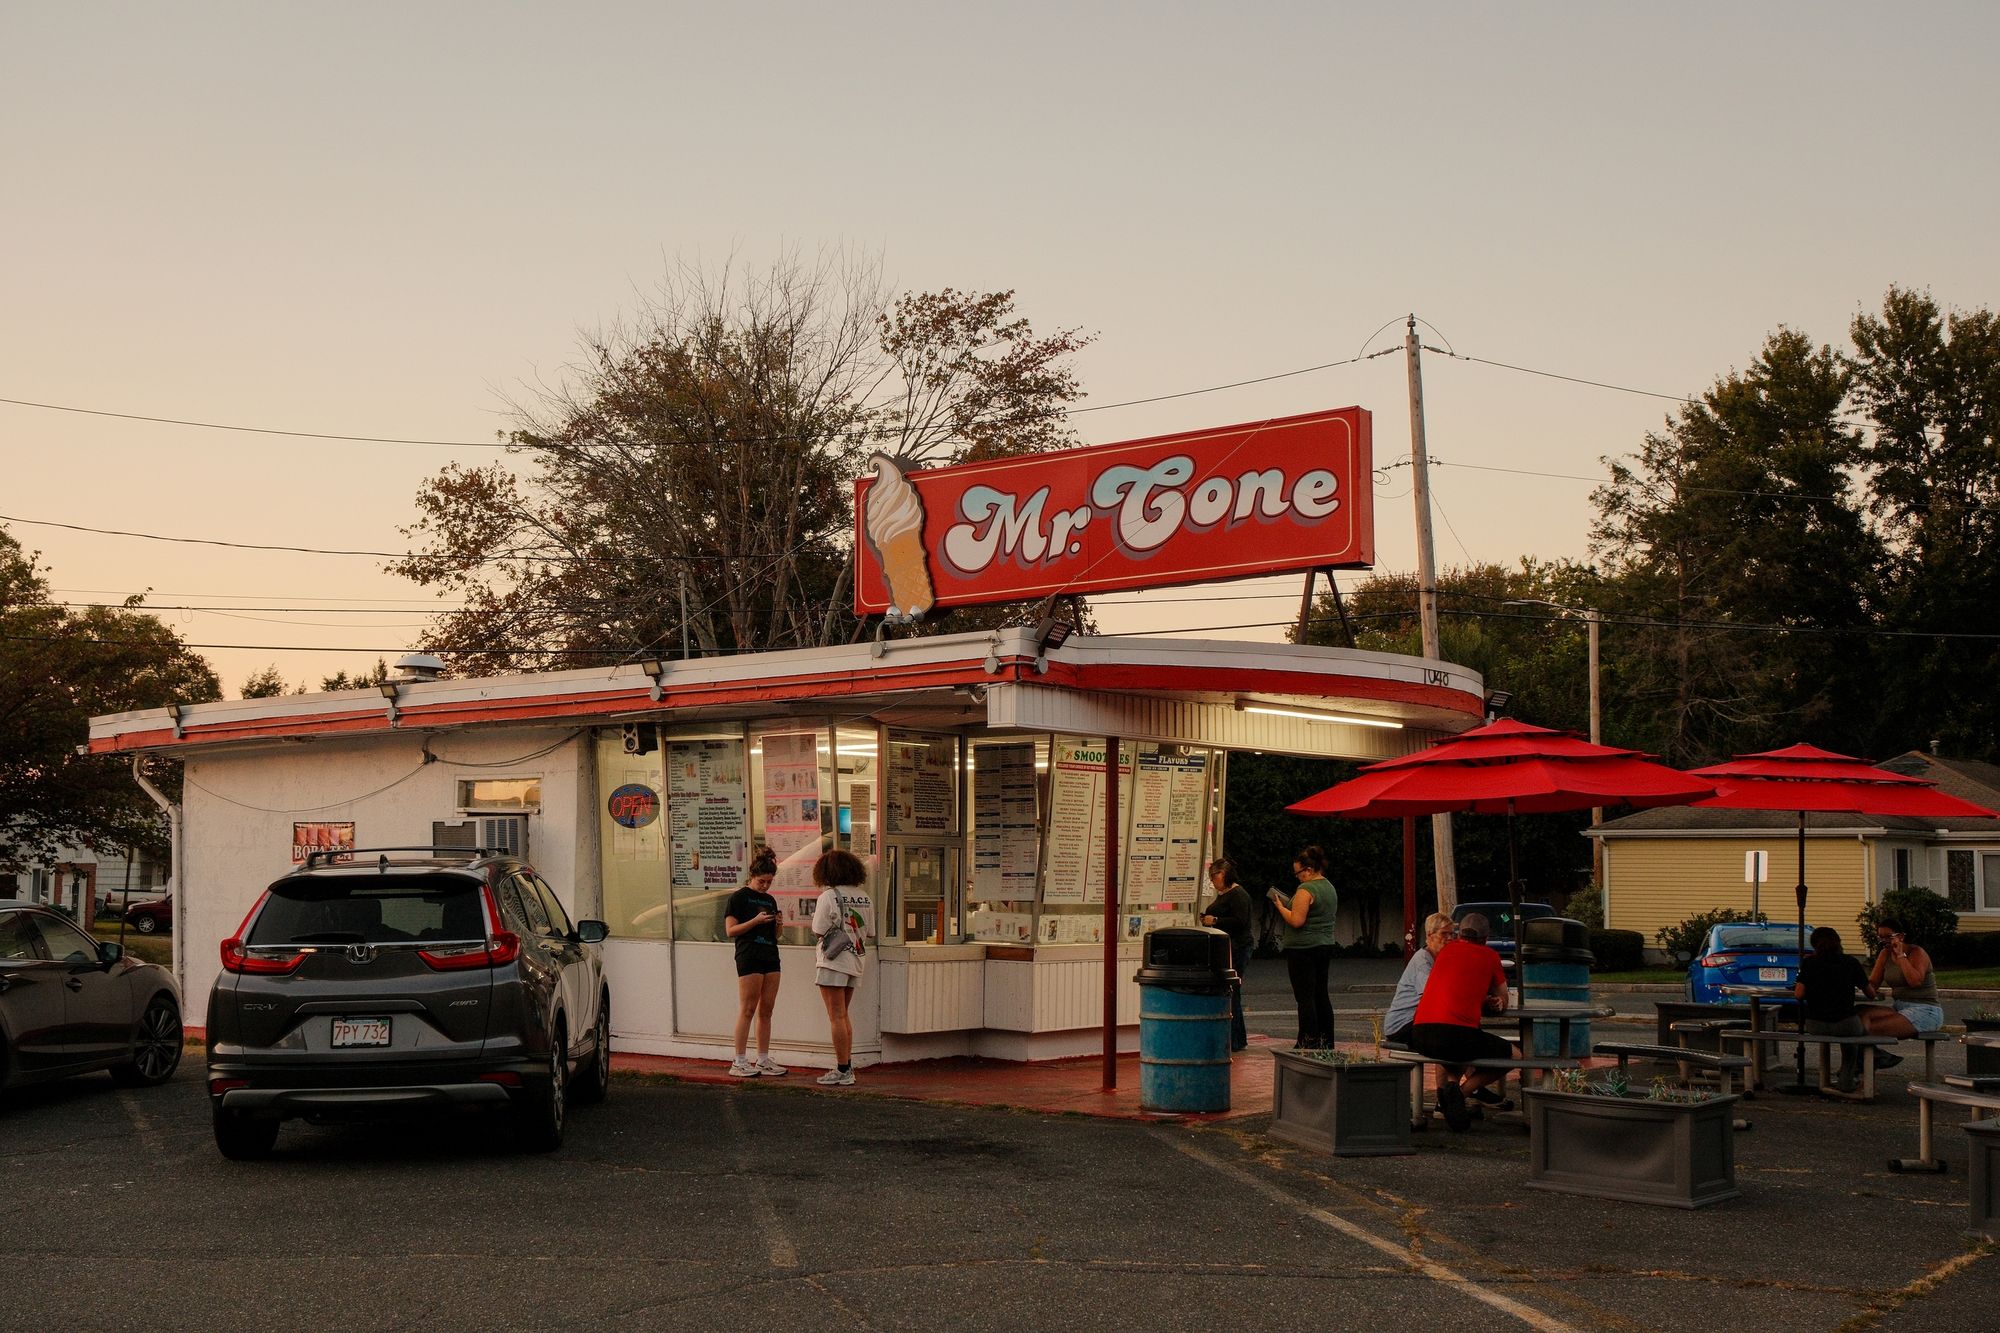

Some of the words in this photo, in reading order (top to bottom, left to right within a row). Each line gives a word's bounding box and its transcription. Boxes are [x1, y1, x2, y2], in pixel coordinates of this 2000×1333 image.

[945, 484, 1091, 572] Mr.
[1092, 455, 1339, 551] Cone
[1074, 750, 1130, 764] SMOOTES
[612, 795, 652, 817] OPEN
[834, 896, 871, 904] E.A.C.E.
[335, 1025, 359, 1040] 7PY
[363, 1024, 388, 1039] 732
